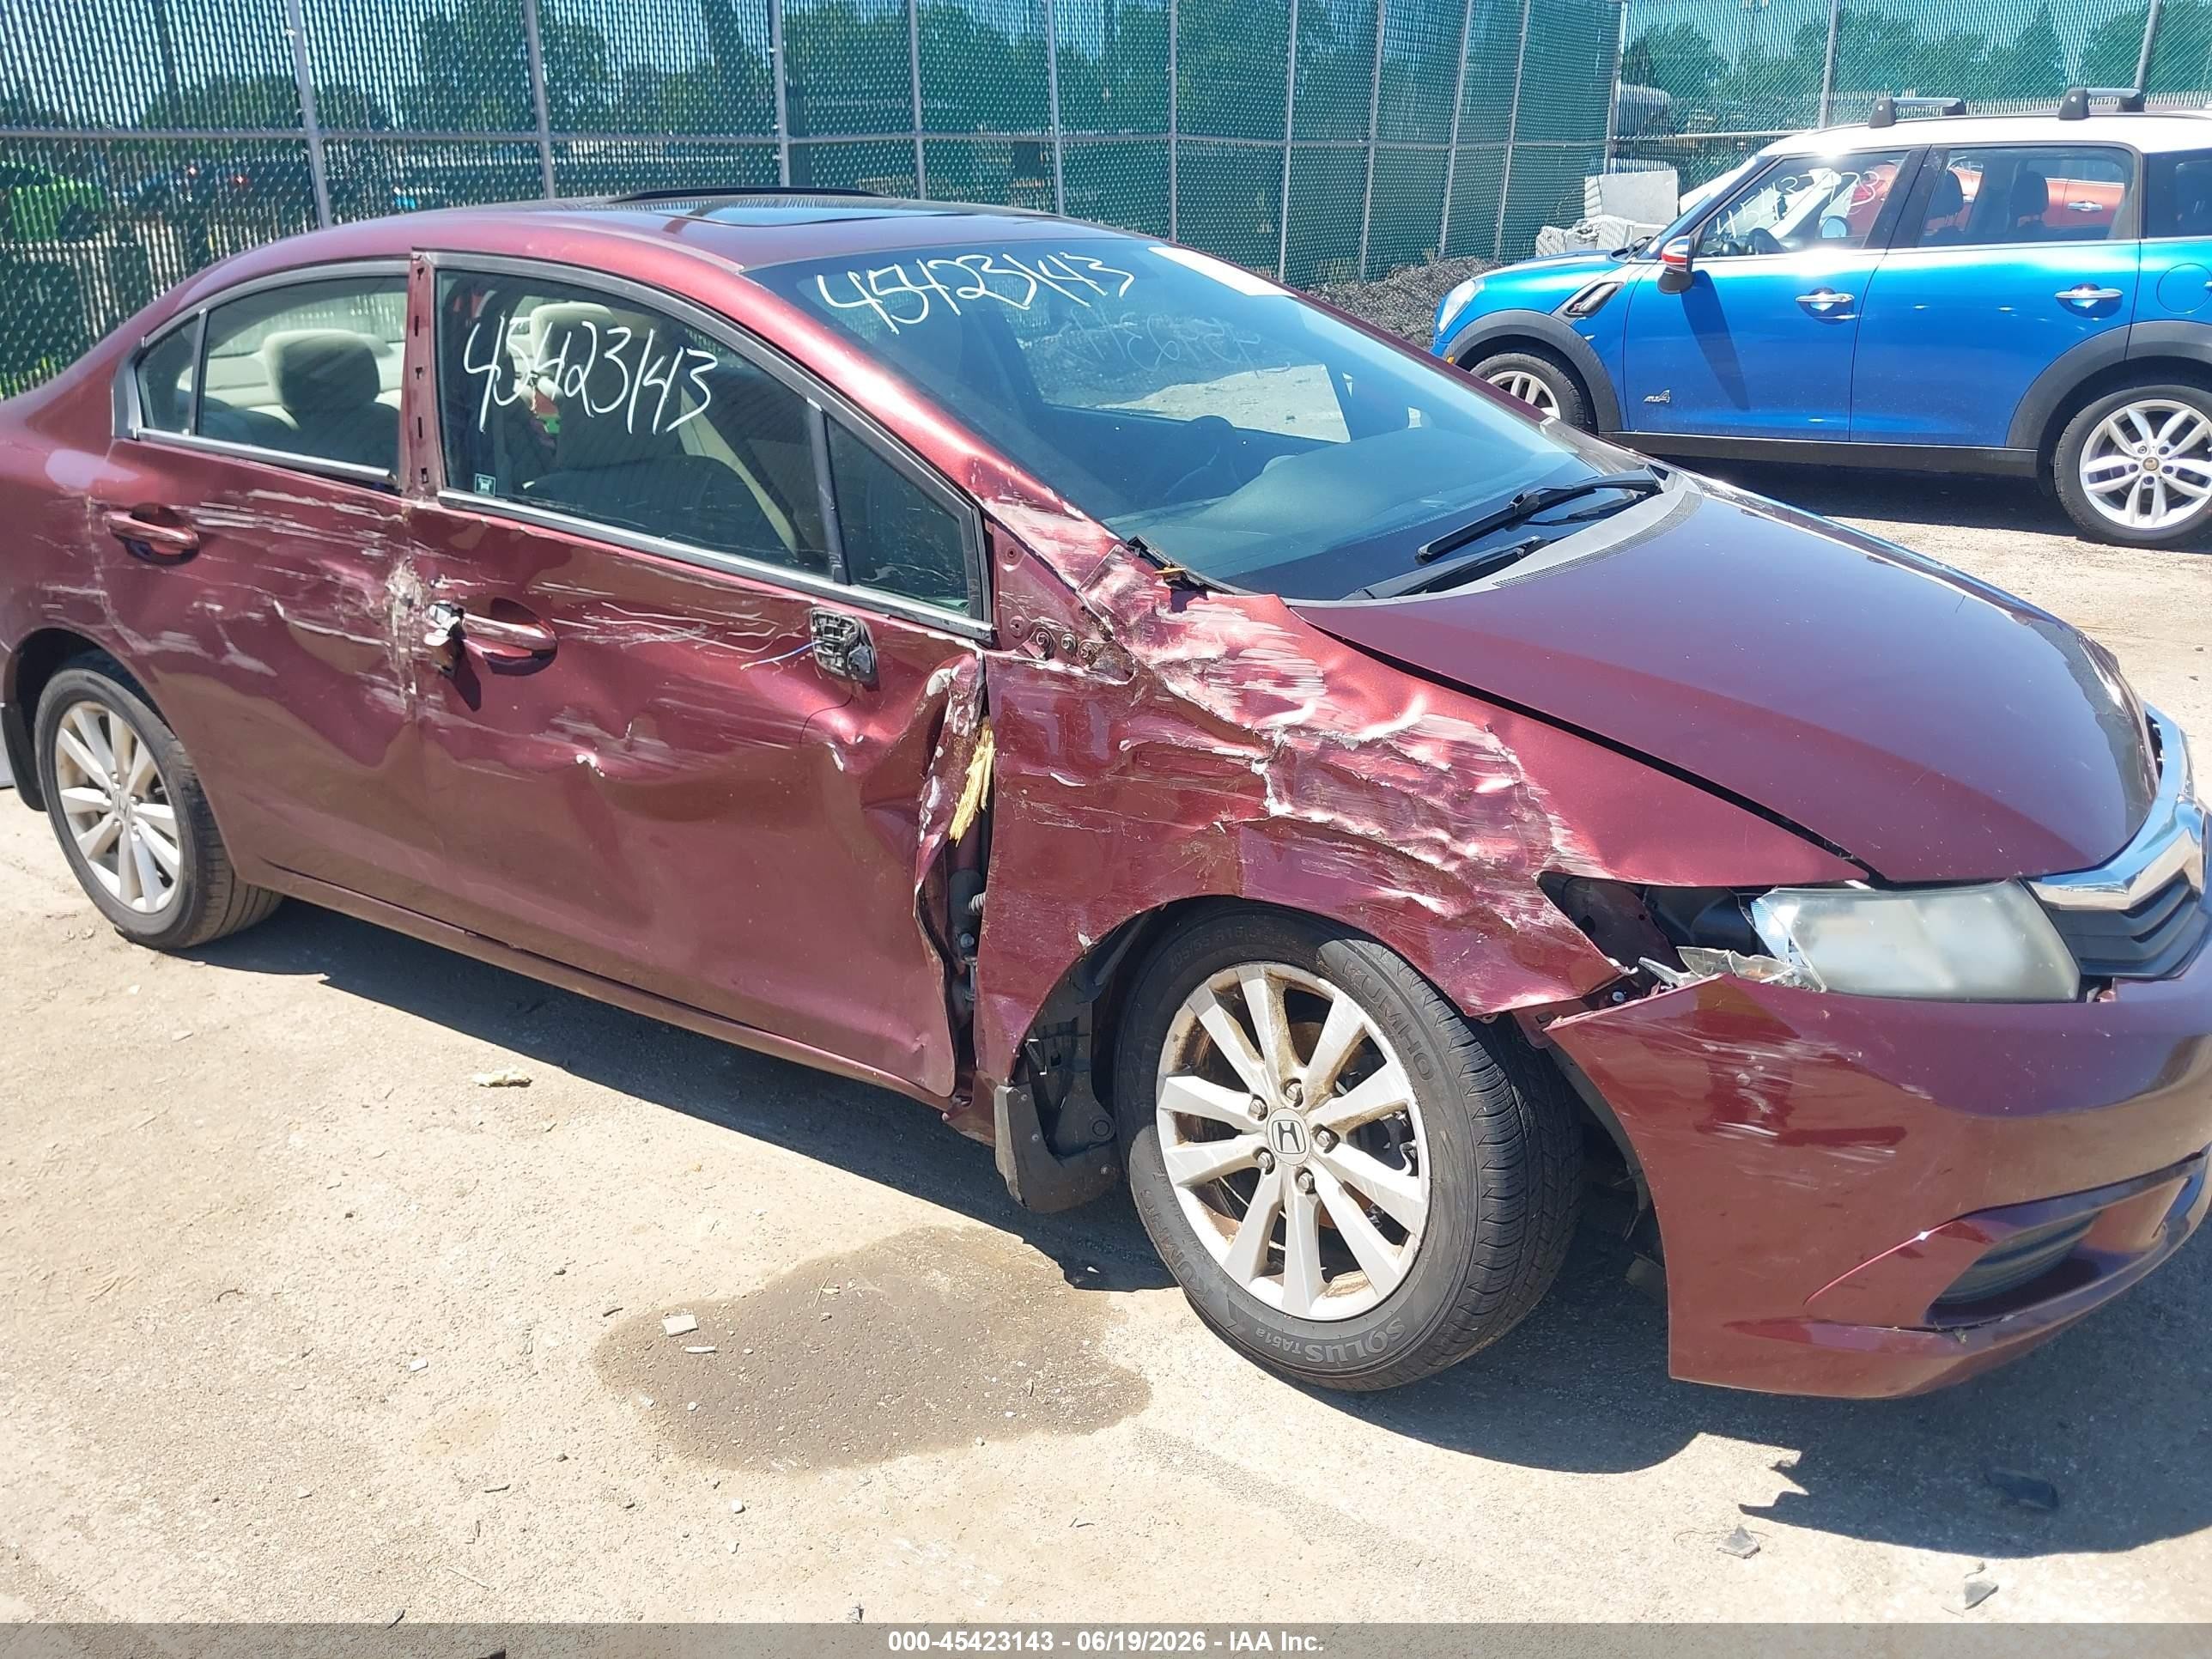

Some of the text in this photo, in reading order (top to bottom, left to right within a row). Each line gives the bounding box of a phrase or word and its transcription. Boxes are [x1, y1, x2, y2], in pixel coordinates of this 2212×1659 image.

[817, 252, 1135, 335] 45423143
[463, 315, 718, 434] 45423143
[1342, 957, 1436, 1081] KUMHO
[1255, 1317, 1407, 1364] SOLUS TA51a
